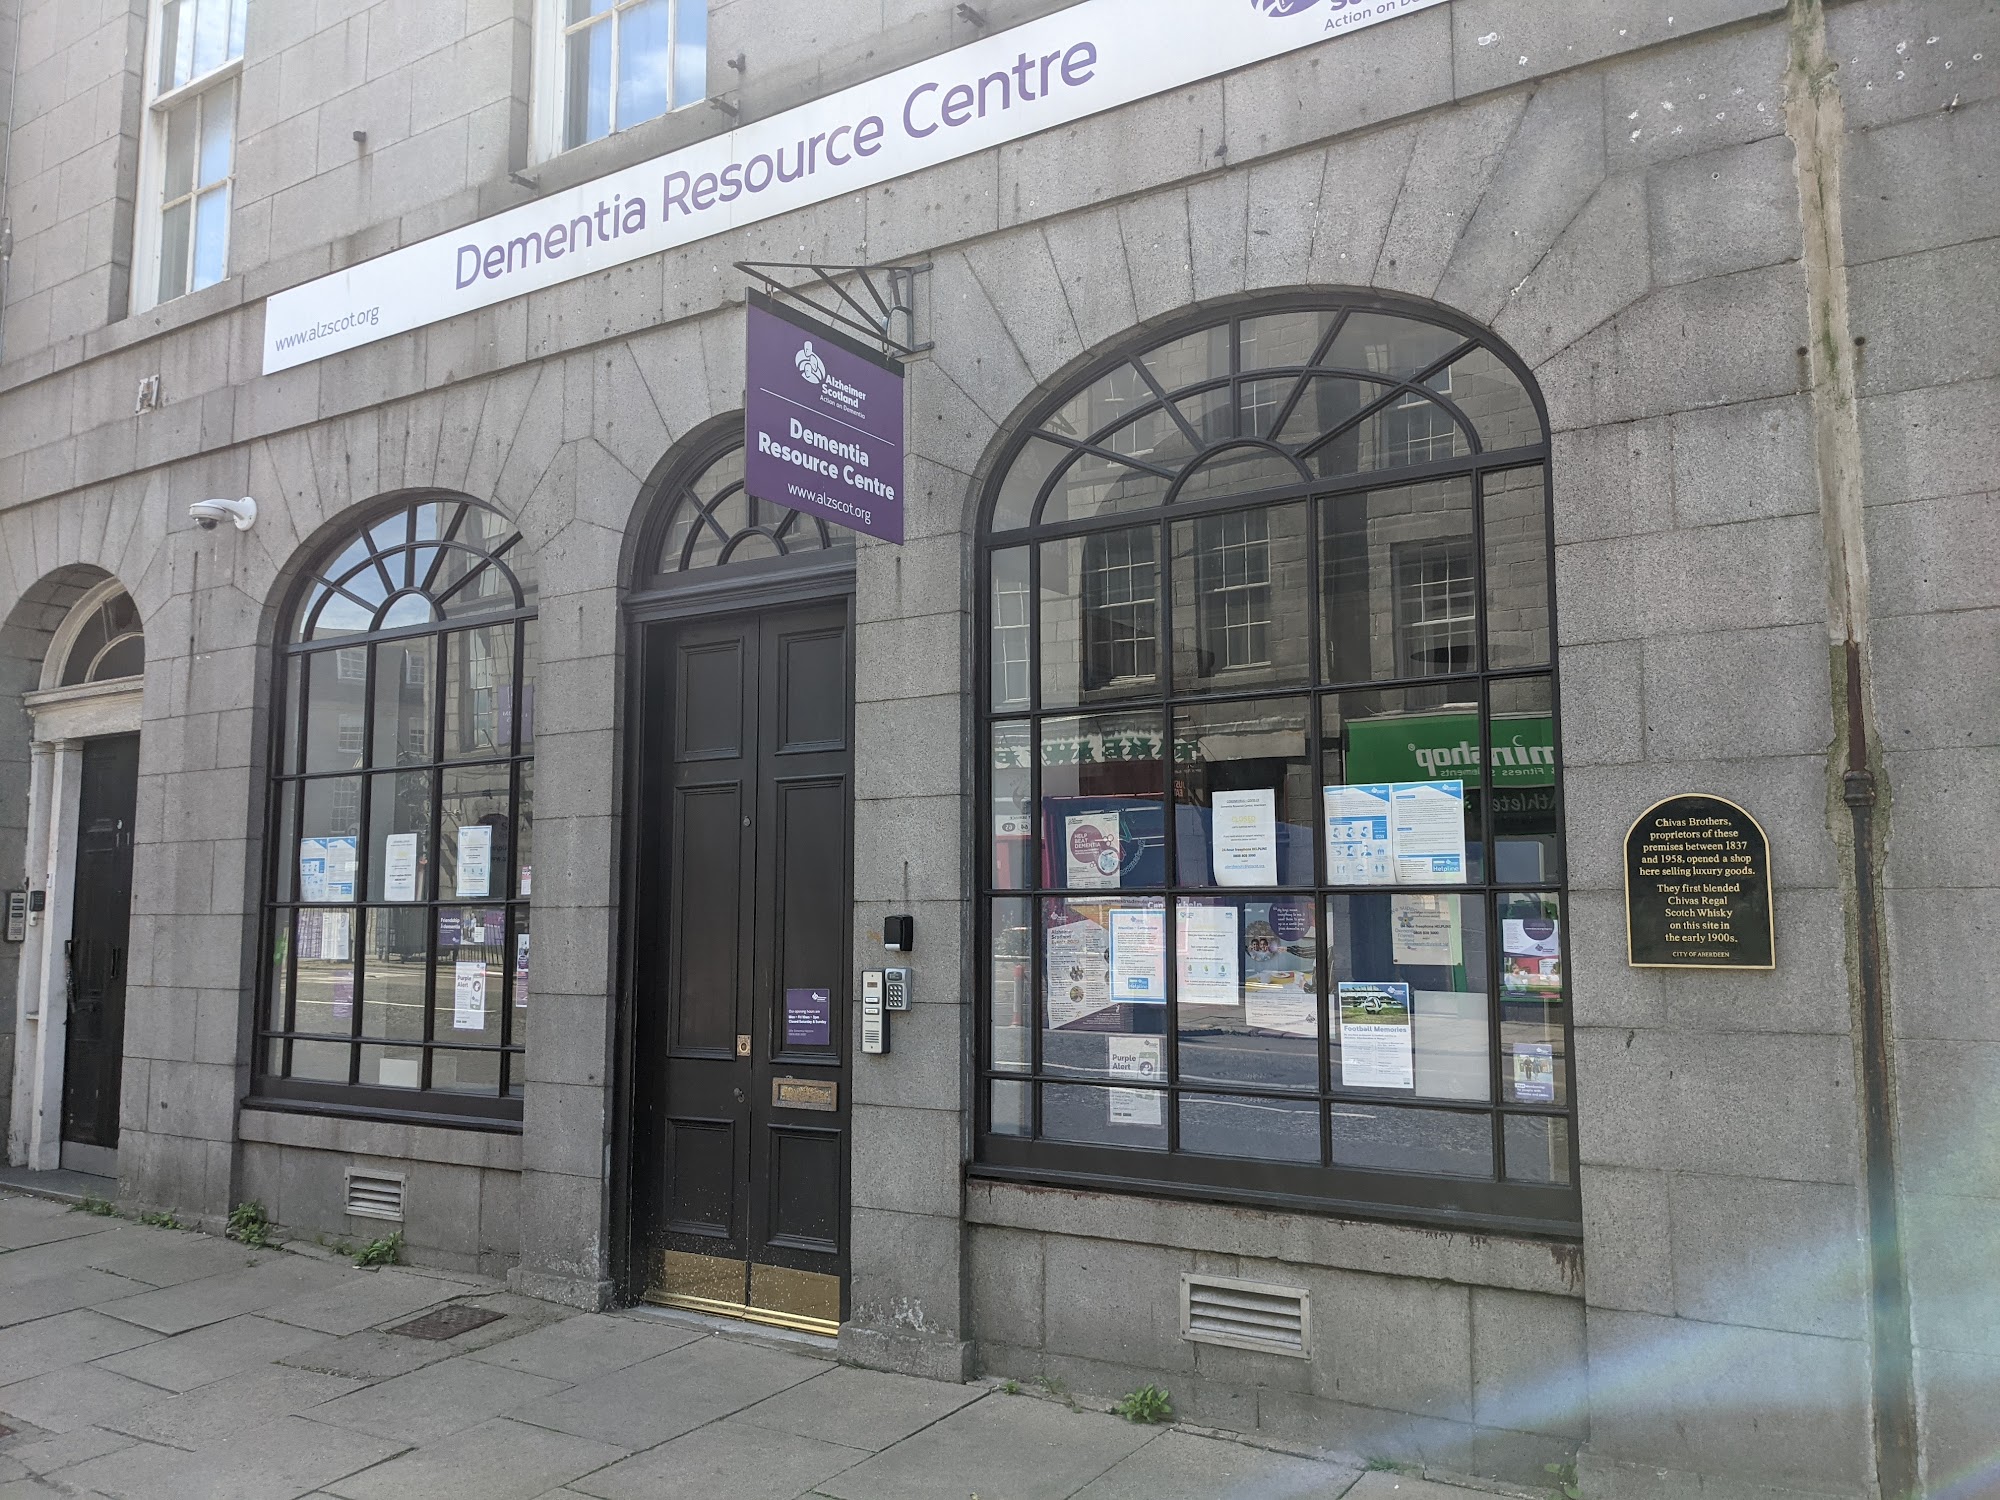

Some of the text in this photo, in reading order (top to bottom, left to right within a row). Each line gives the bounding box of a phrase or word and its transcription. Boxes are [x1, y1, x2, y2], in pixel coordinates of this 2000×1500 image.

[1324, 9, 1372, 31] Action
[1377, 2, 1396, 15] on
[455, 41, 1097, 290] Dementia Resource Centre
[275, 306, 380, 352] www.alzscot.org
[825, 374, 867, 401] Alzheimer
[821, 384, 859, 409] Scotland
[819, 394, 836, 407] Action
[843, 403, 866, 419] Dementia
[790, 417, 869, 468] Dementia
[758, 430, 895, 501] Resource Centre
[787, 482, 872, 525] www.alzscot.org
[1655, 817, 1731, 827] Chivas Brothers,
[1650, 829, 1739, 841] proprietors of these
[1643, 841, 1747, 853] premises between 1837
[1642, 855, 1658, 864] and
[1661, 855, 1685, 865] 1958,
[1687, 854, 1719, 865] opened
[1730, 854, 1751, 865] shop
[1639, 866, 1755, 877] here selling luxury goods.
[1657, 884, 1740, 894] They first blended
[1668, 896, 1727, 906] Chivas Regal
[1665, 908, 1732, 918] Scotch Whisky
[1683, 921, 1700, 929] this
[1702, 921, 1719, 929] site
[1721, 921, 1730, 929] in
[1665, 933, 1738, 943] the early 1900s.
[1112, 1054, 1137, 1063] Purple
[1112, 1062, 1131, 1070] Alert
